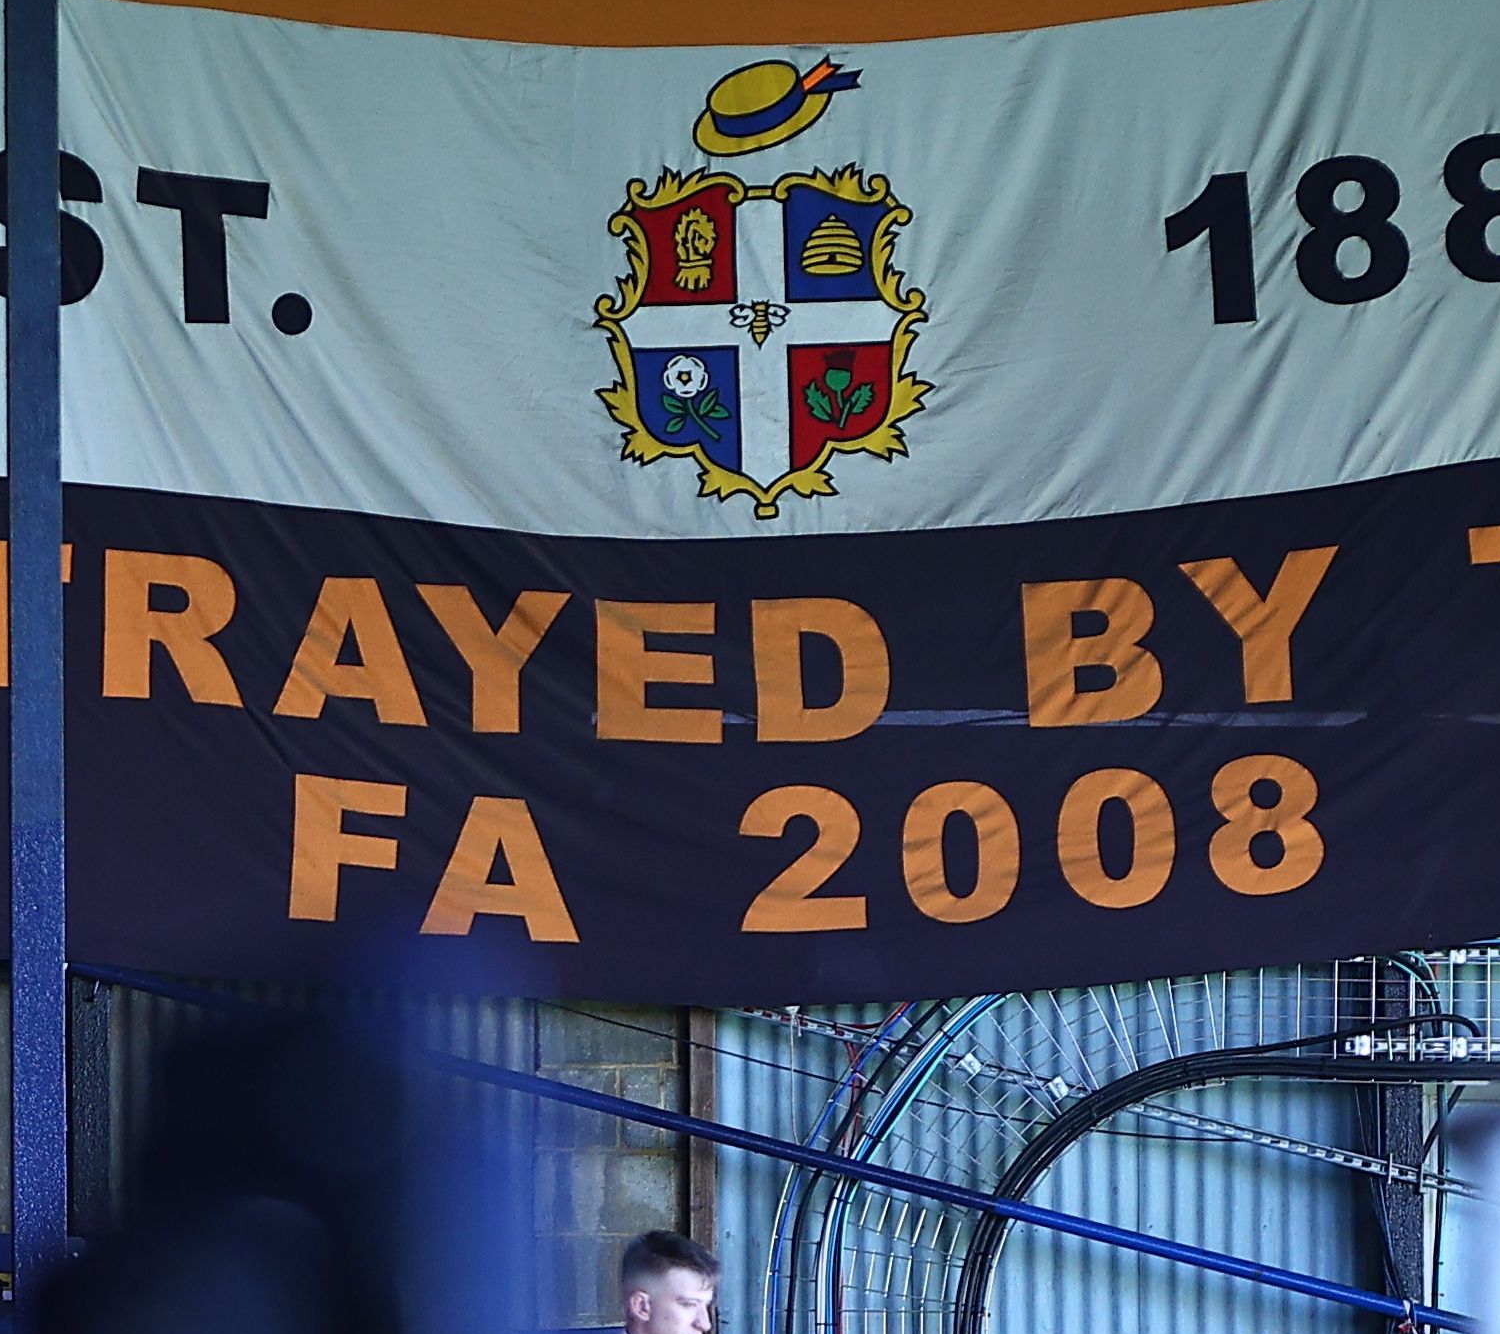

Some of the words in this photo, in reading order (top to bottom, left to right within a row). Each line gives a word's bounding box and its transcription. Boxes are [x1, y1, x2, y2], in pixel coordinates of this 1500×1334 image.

[1021, 545, 1339, 728] BY
[288, 773, 581, 944] FA
[738, 754, 1326, 933] 2008
